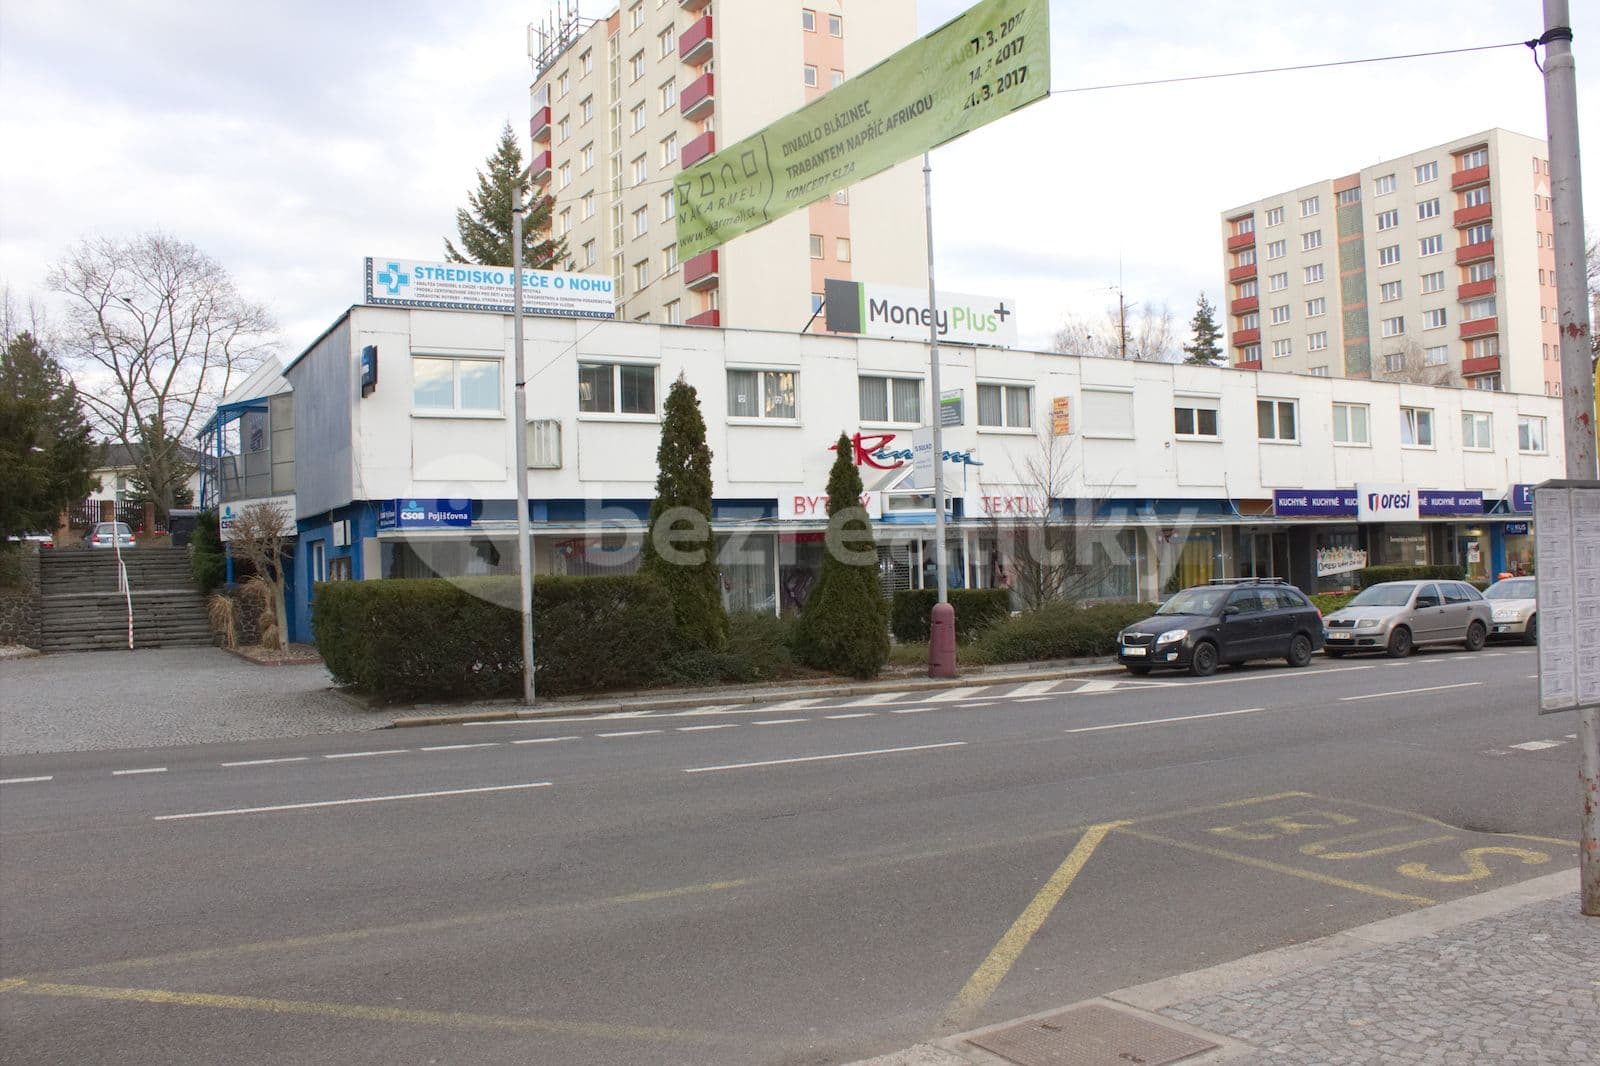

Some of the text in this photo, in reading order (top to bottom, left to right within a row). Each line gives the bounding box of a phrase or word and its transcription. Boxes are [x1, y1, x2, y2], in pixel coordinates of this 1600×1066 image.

[782, 100, 872, 157] DIVADLO BLÁZINEC
[786, 94, 934, 180] TRABANTEM NAPŘÍČ AFRIKOU
[785, 173, 831, 199] KONCERT
[414, 265, 504, 285] STŘEDISKO
[553, 276, 564, 289] O
[569, 278, 612, 292] NOHU
[794, 492, 1038, 515] BYTÝ TEXTIL
[1381, 490, 1411, 509] oresi
[428, 511, 468, 521] Pojišťovna
